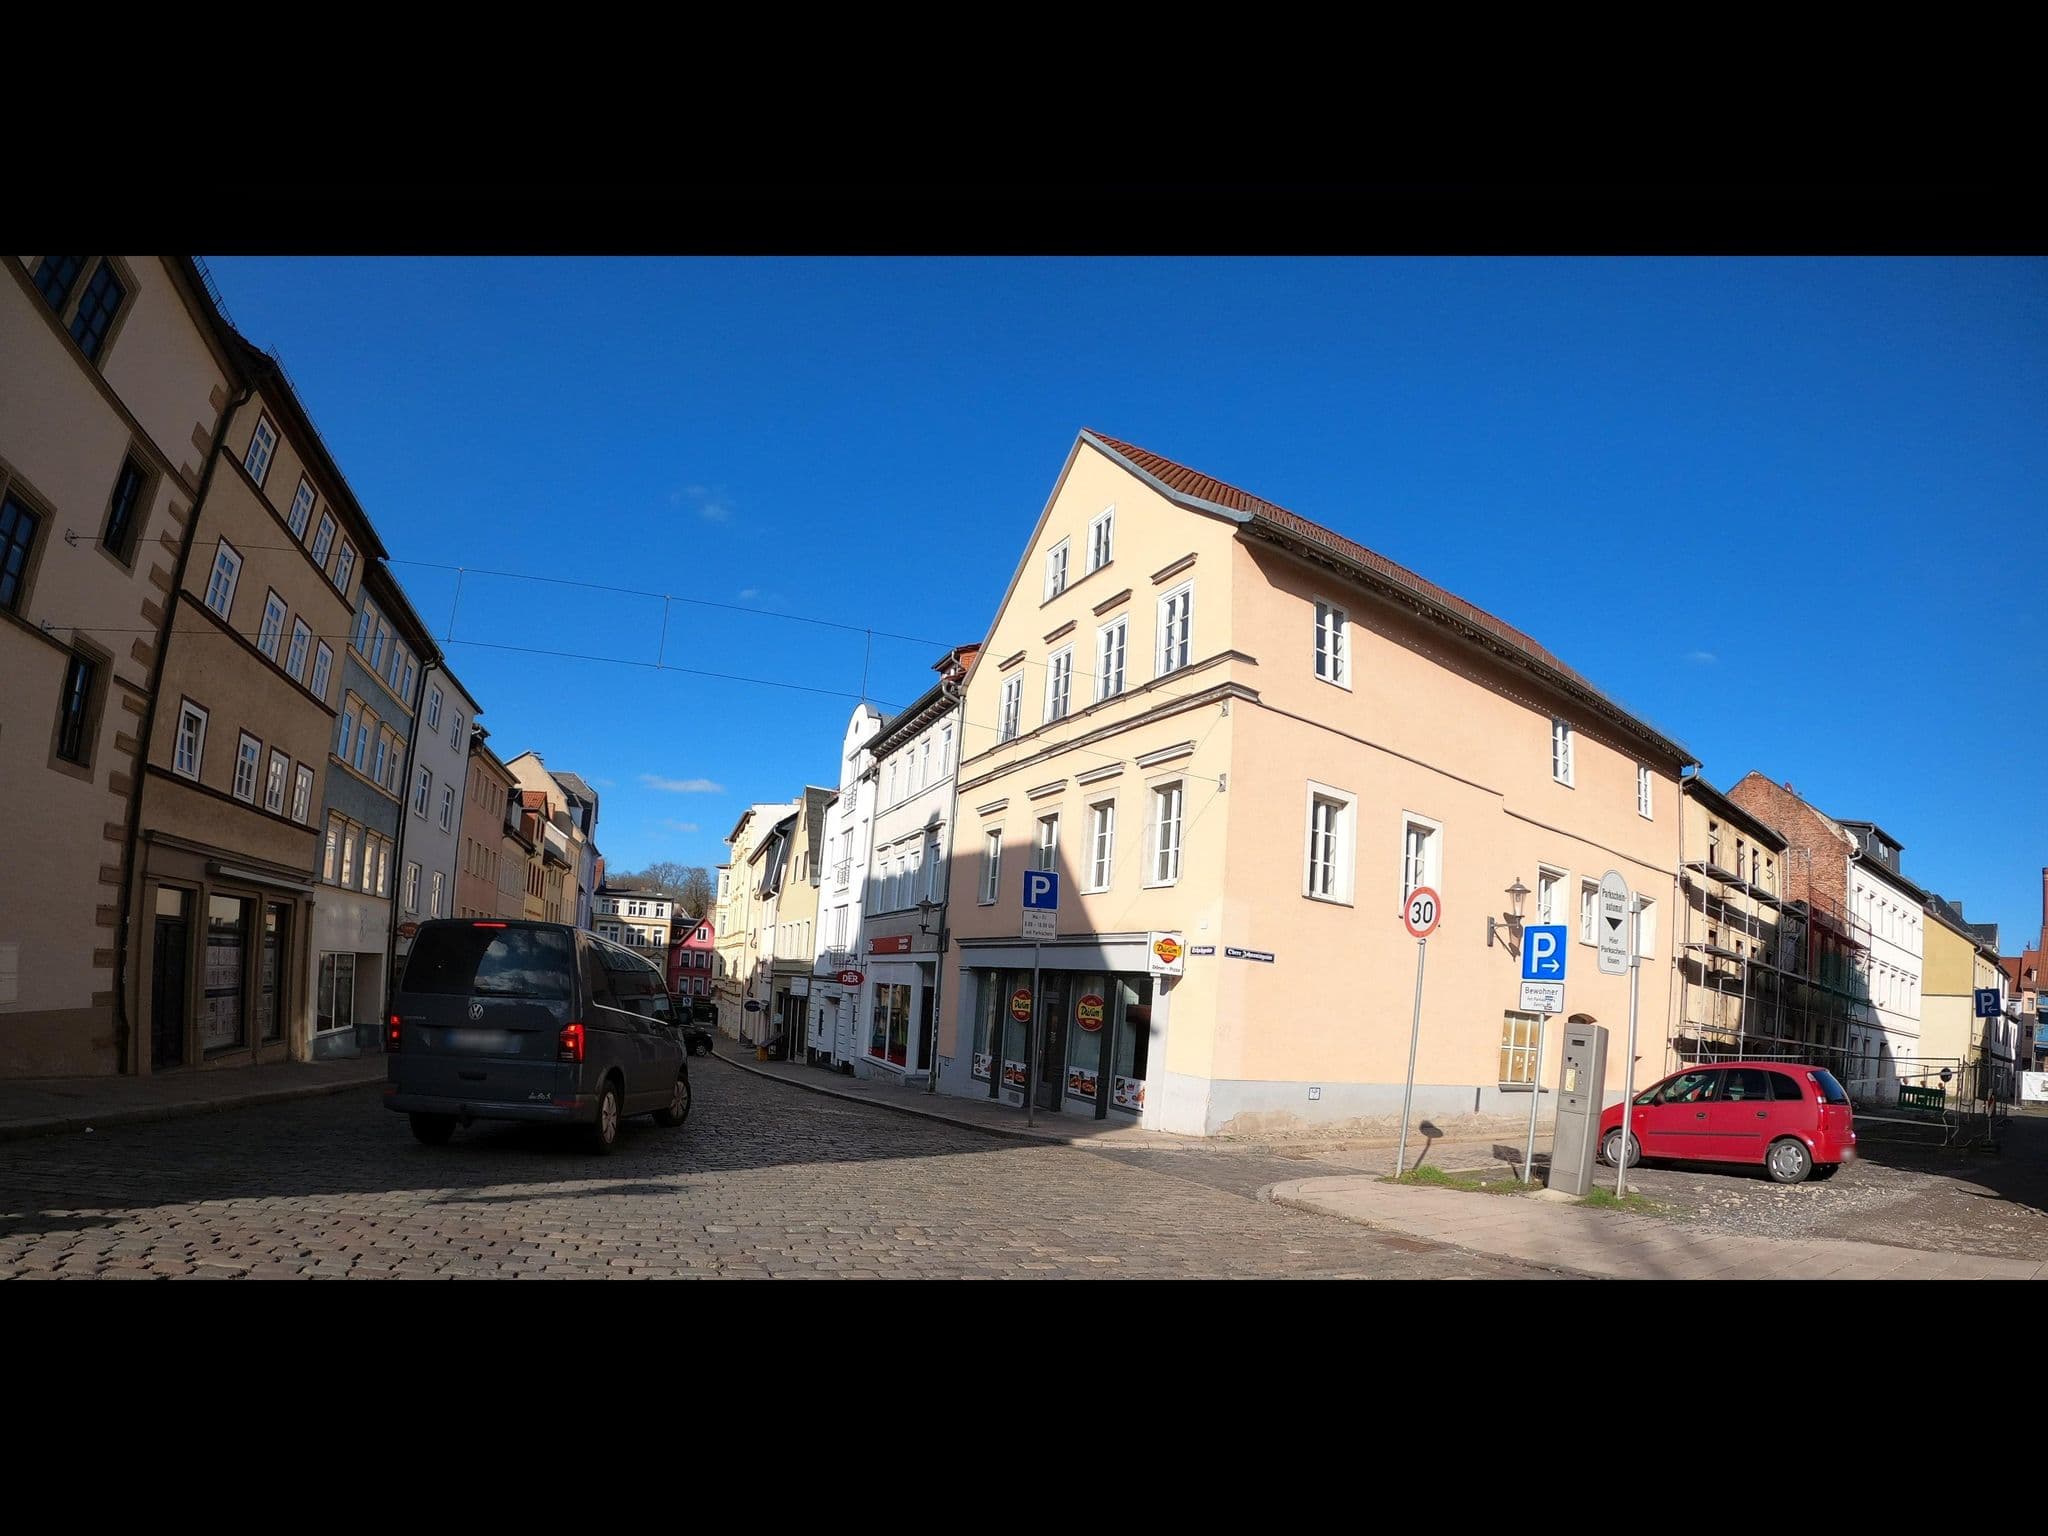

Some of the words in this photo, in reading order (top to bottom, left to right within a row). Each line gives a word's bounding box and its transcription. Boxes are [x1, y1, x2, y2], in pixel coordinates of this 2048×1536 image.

[1031, 875, 1051, 904] P
[1411, 901, 1434, 924] 30
[1609, 936, 1619, 945] Hier
[1531, 932, 1557, 973] P
[1601, 945, 1626, 956] Parkschein
[842, 974, 858, 983] DER
[1525, 986, 1558, 996] Bewohner
[1980, 992, 1995, 1014] P
